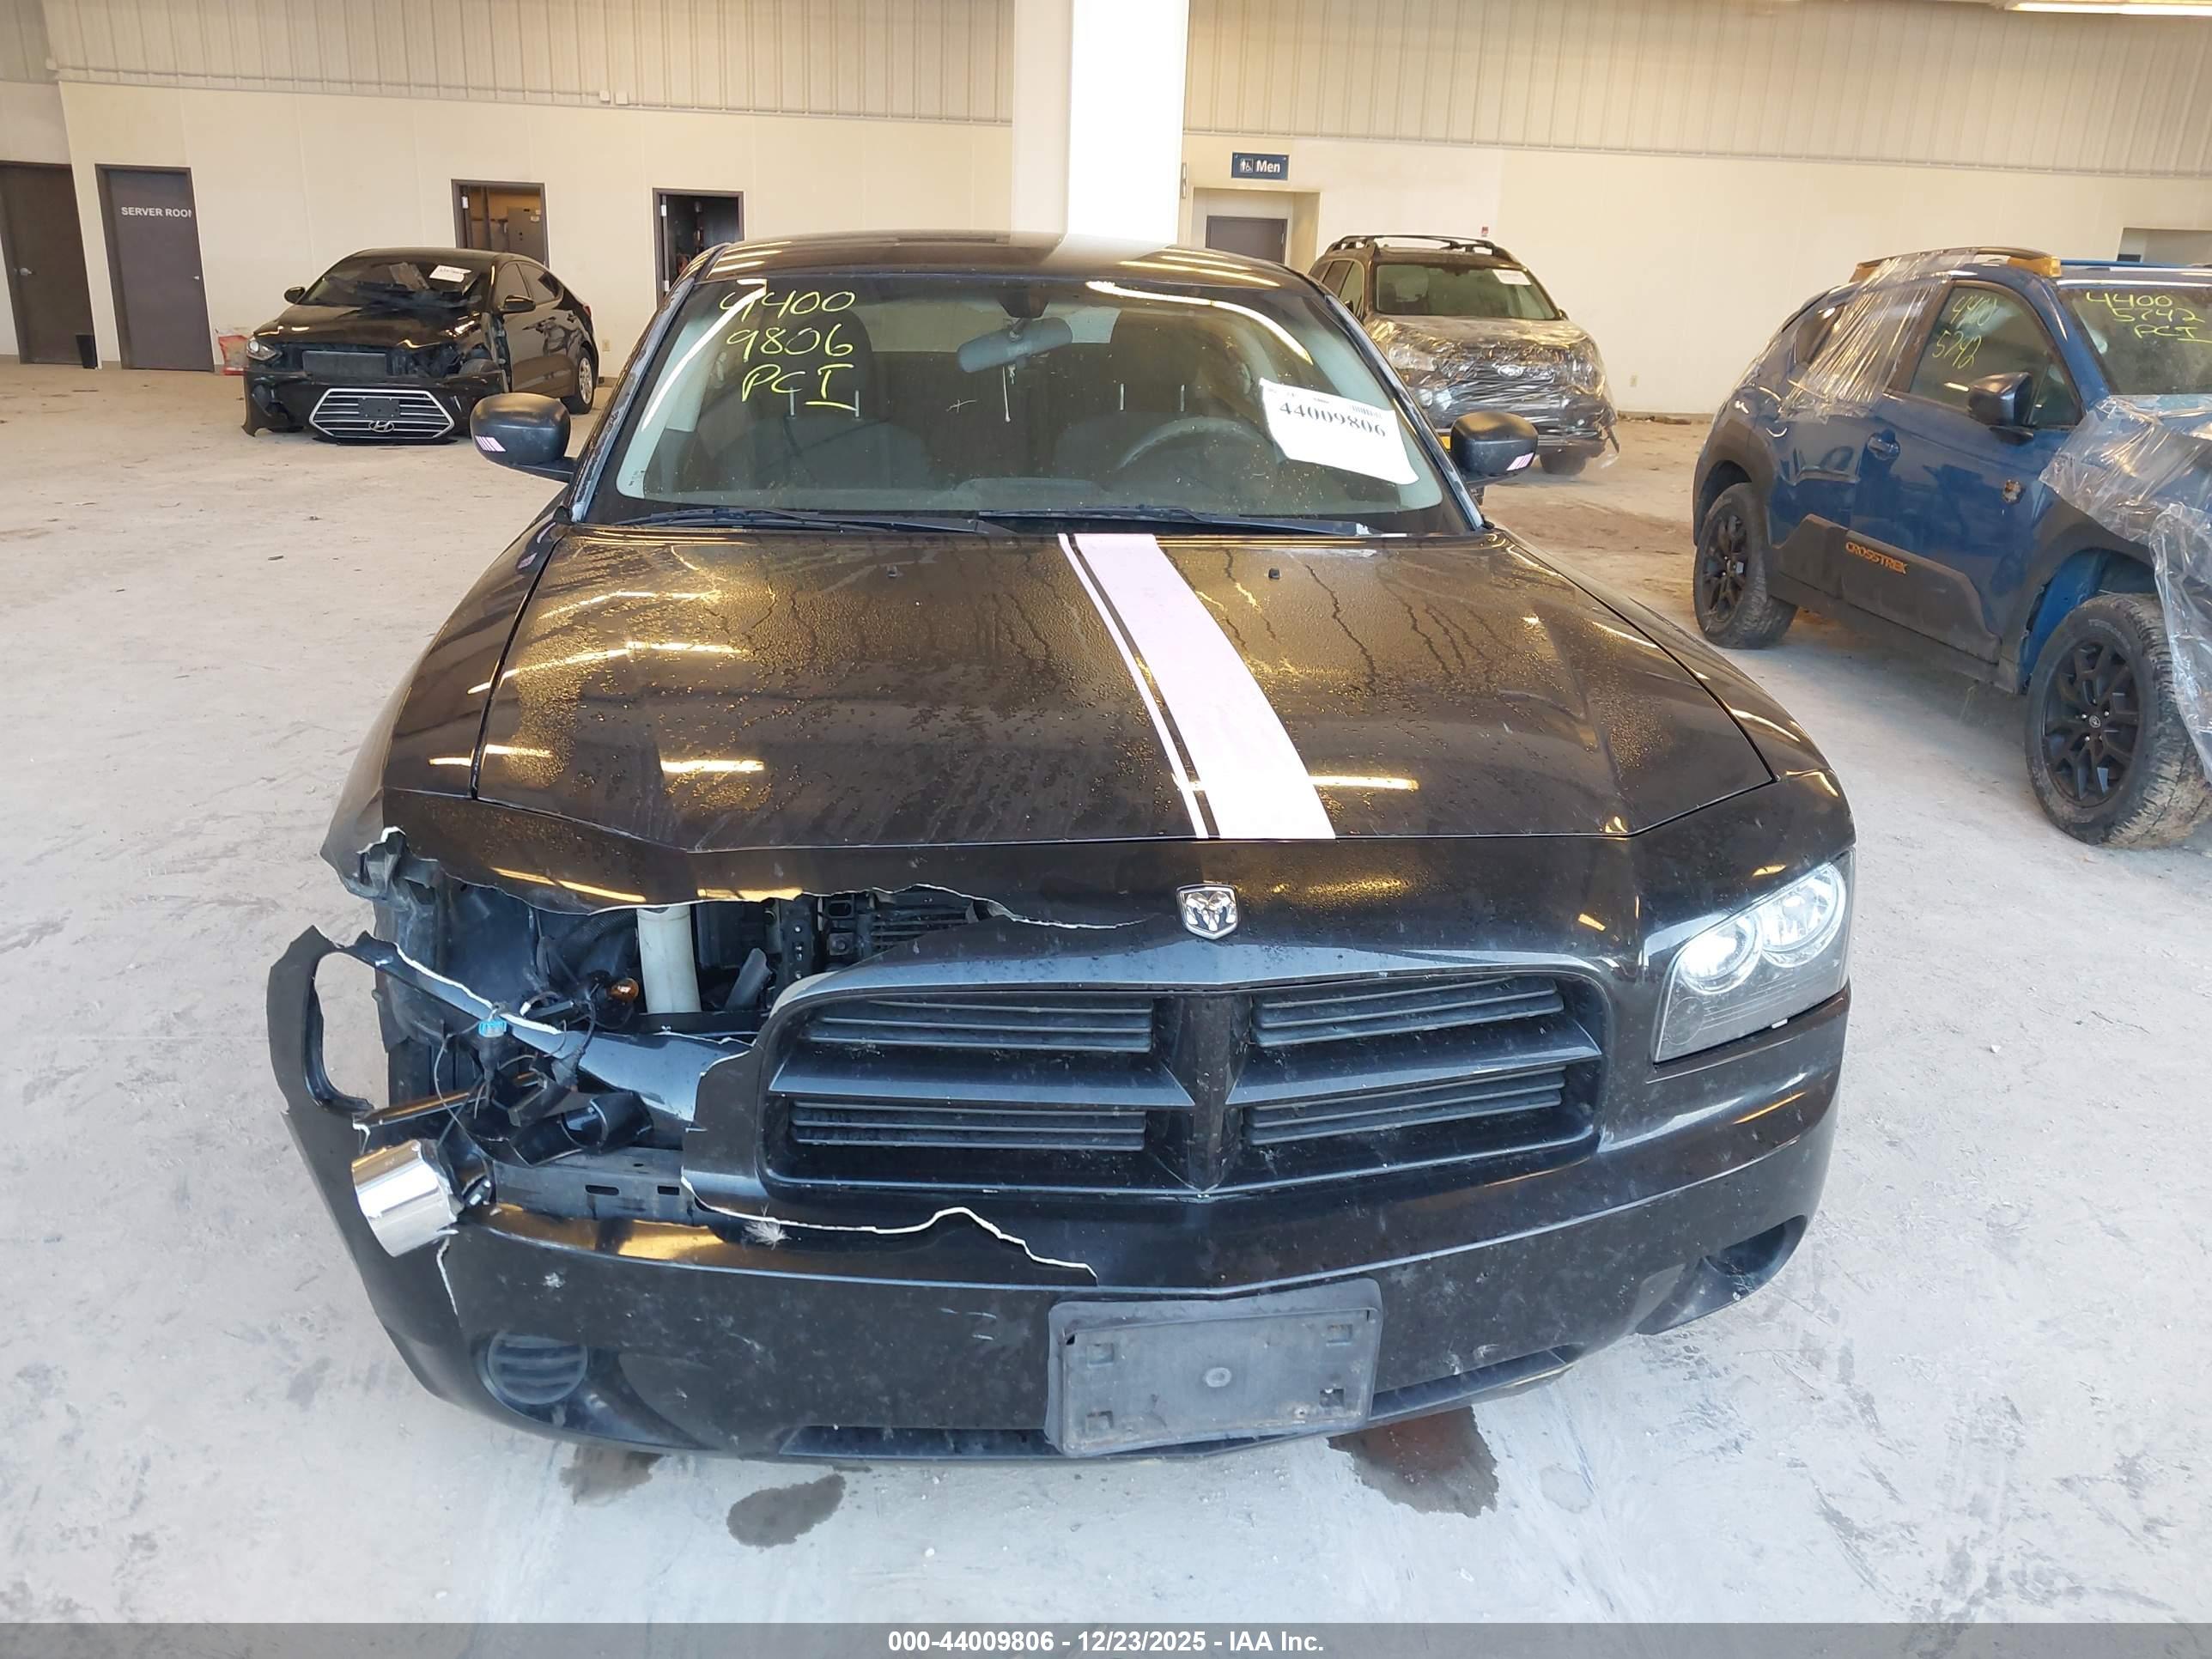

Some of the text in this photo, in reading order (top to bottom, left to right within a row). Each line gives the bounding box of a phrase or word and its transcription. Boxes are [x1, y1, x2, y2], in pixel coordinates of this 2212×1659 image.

[1256, 160, 1280, 173] Men
[121, 207, 163, 216] SERVER
[2086, 292, 2172, 308] 4400
[726, 324, 853, 362] 9806
[1932, 329, 1982, 369] 5742
[1279, 402, 1386, 437] 44009806
[1845, 542, 1908, 574] CROSSTREK
